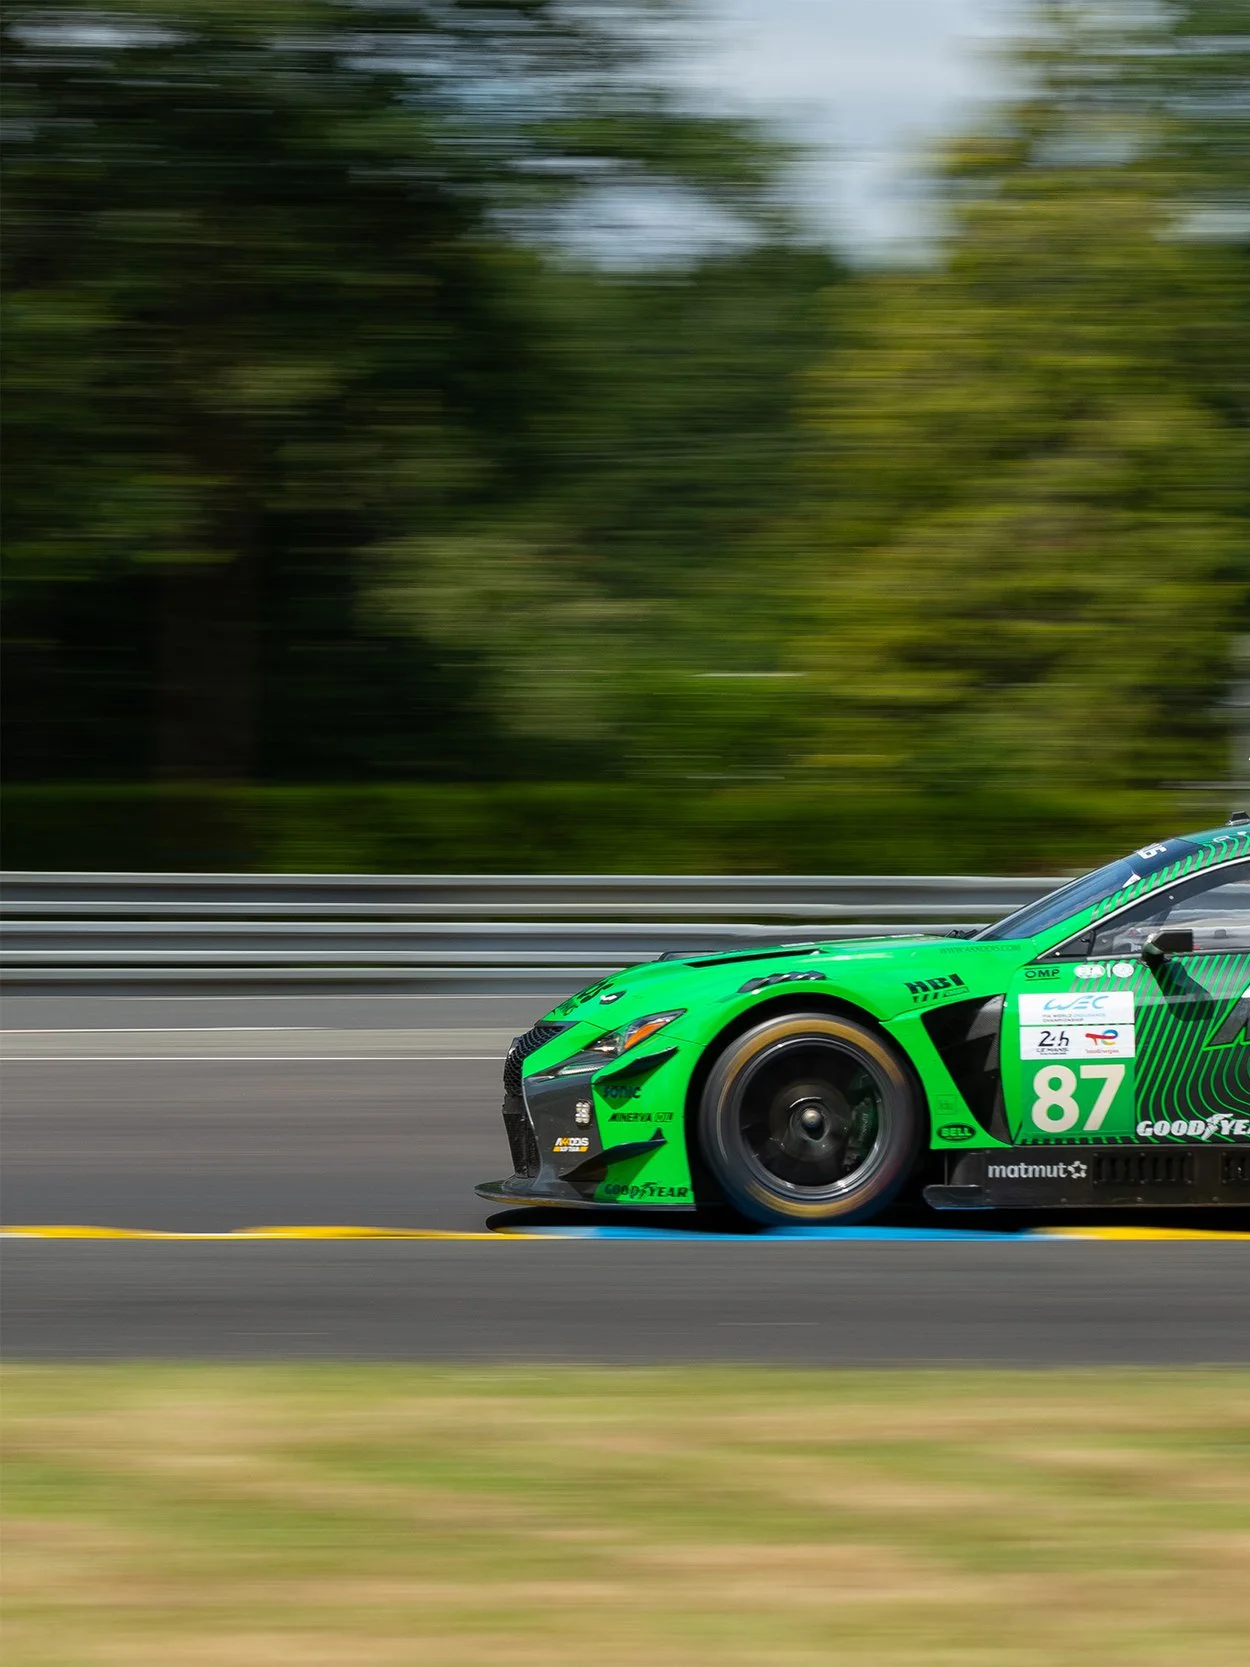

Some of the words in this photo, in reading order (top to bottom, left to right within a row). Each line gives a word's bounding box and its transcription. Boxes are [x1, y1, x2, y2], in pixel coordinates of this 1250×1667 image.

[1025, 968, 1060, 978] OMP
[904, 973, 965, 994] HBI
[1043, 995, 1109, 1010] WEC
[1031, 1064, 1125, 1133] 87
[941, 1127, 972, 1137] BELL
[987, 1162, 1068, 1178] matmut
[604, 1183, 688, 1199] GOODYEAR
